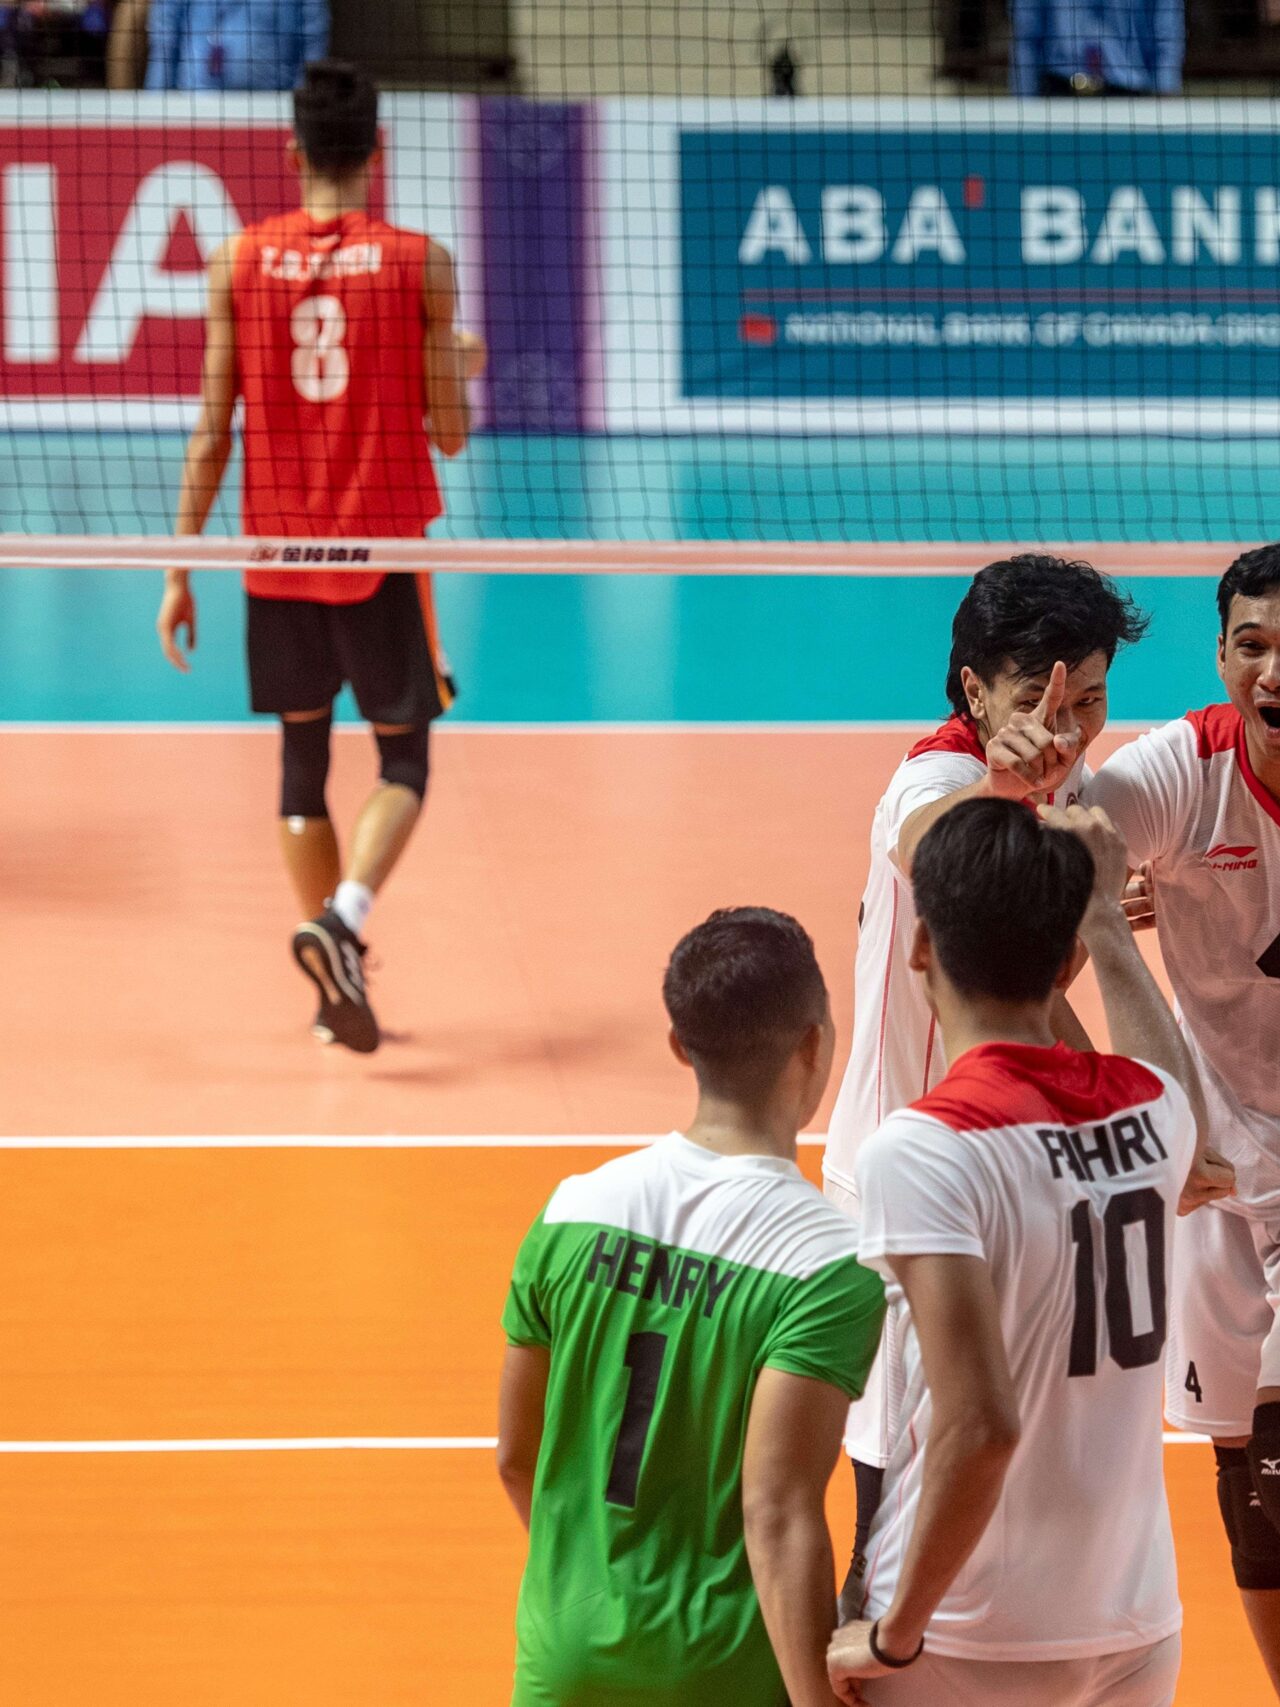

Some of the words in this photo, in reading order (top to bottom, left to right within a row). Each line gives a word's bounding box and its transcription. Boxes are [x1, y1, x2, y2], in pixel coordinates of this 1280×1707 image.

[738, 184, 967, 264] ABA
[290, 294, 350, 403] 8
[1035, 311, 1082, 347] OF
[586, 1231, 737, 1319] HENRY
[1067, 1186, 1167, 1378] 10
[604, 1331, 669, 1508] 1
[1184, 1360, 1203, 1403] 4
